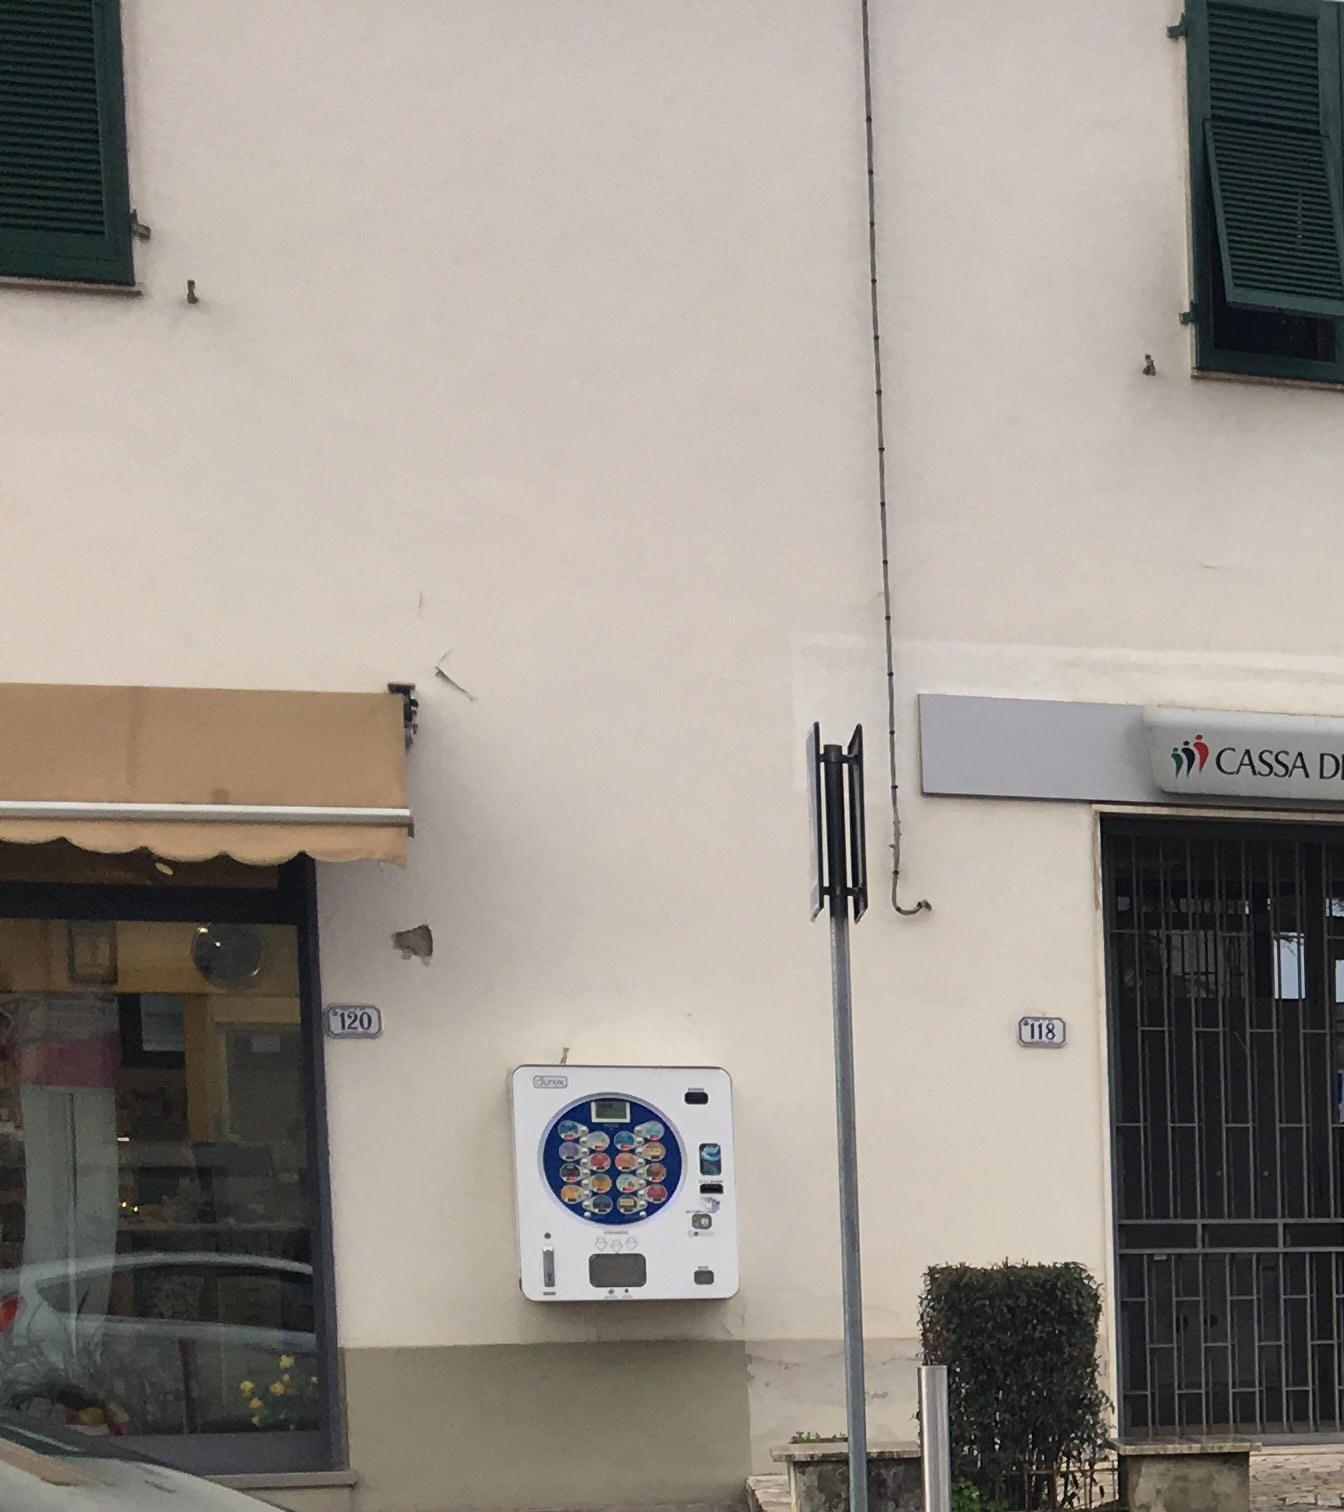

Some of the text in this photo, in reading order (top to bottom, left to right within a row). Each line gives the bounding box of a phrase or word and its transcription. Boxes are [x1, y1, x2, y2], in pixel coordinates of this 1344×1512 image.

[1215, 747, 1310, 780] CASSA
[339, 1011, 372, 1031] 120
[1030, 1022, 1056, 1041] 118
